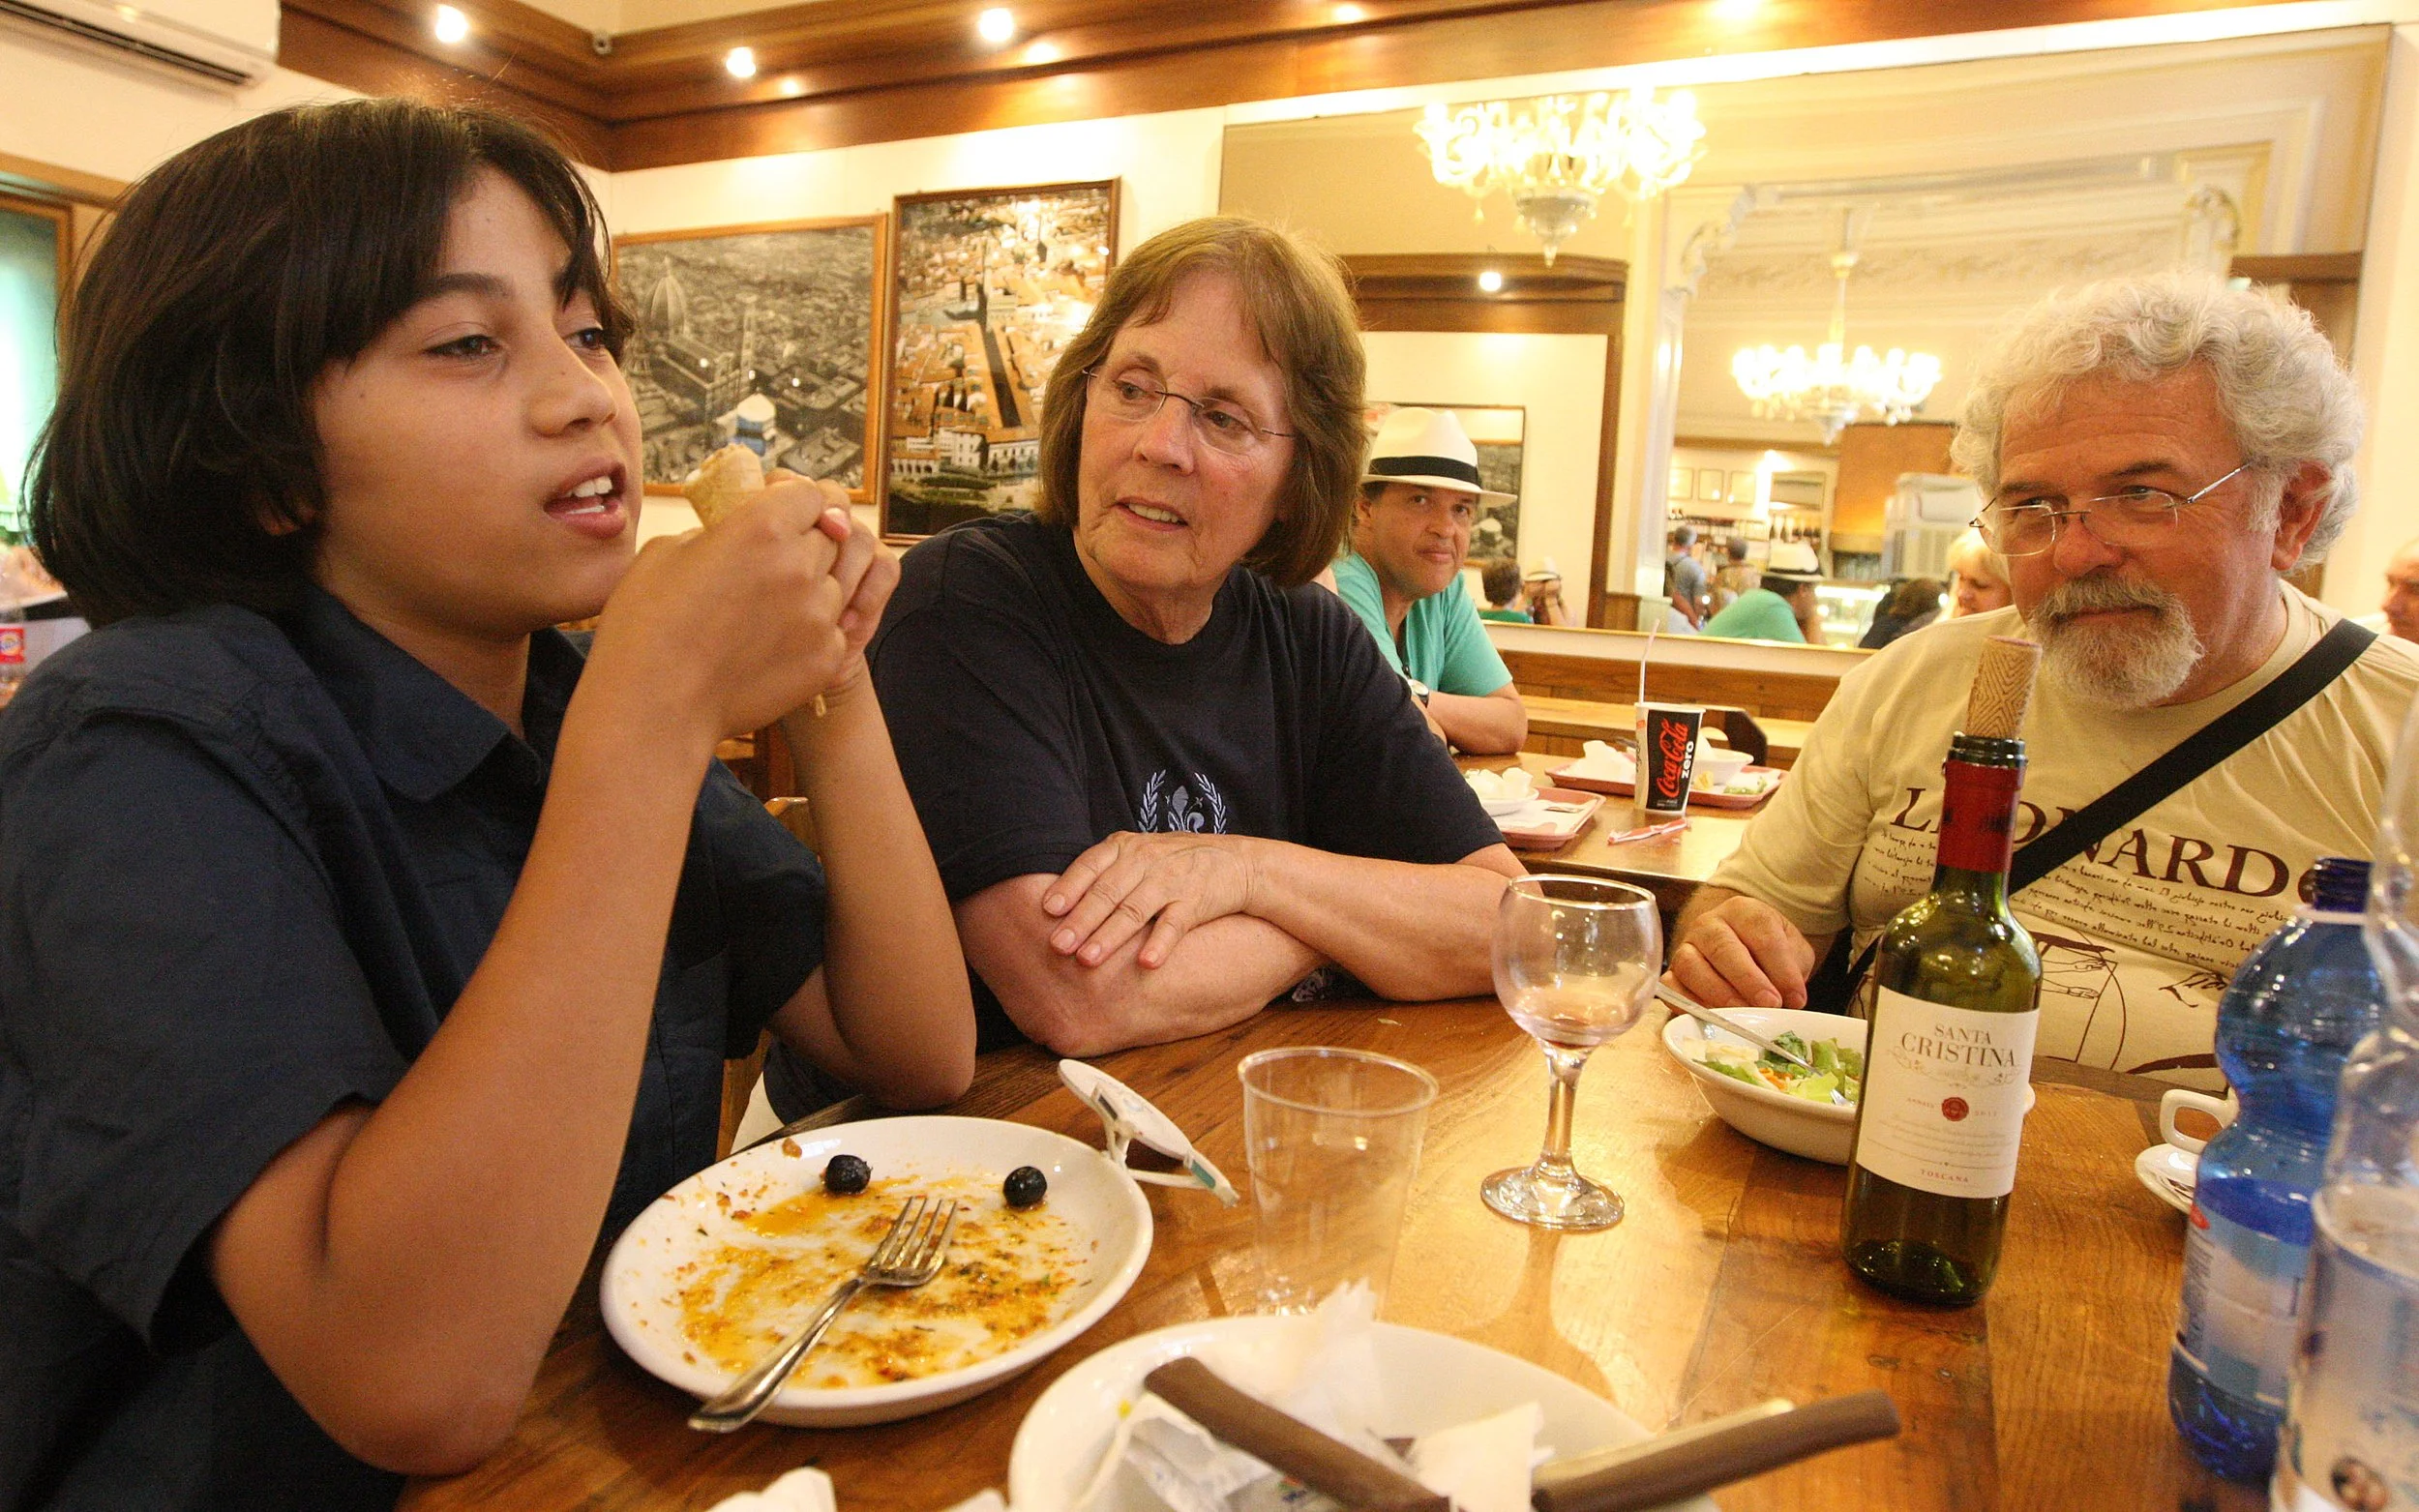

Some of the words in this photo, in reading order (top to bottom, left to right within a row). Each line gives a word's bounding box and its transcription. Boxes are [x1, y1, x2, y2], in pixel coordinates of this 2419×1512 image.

[1682, 741, 1694, 779] zero
[1901, 1031, 2016, 1067] CRISTINA
[1934, 1023, 1991, 1045] SANTA
